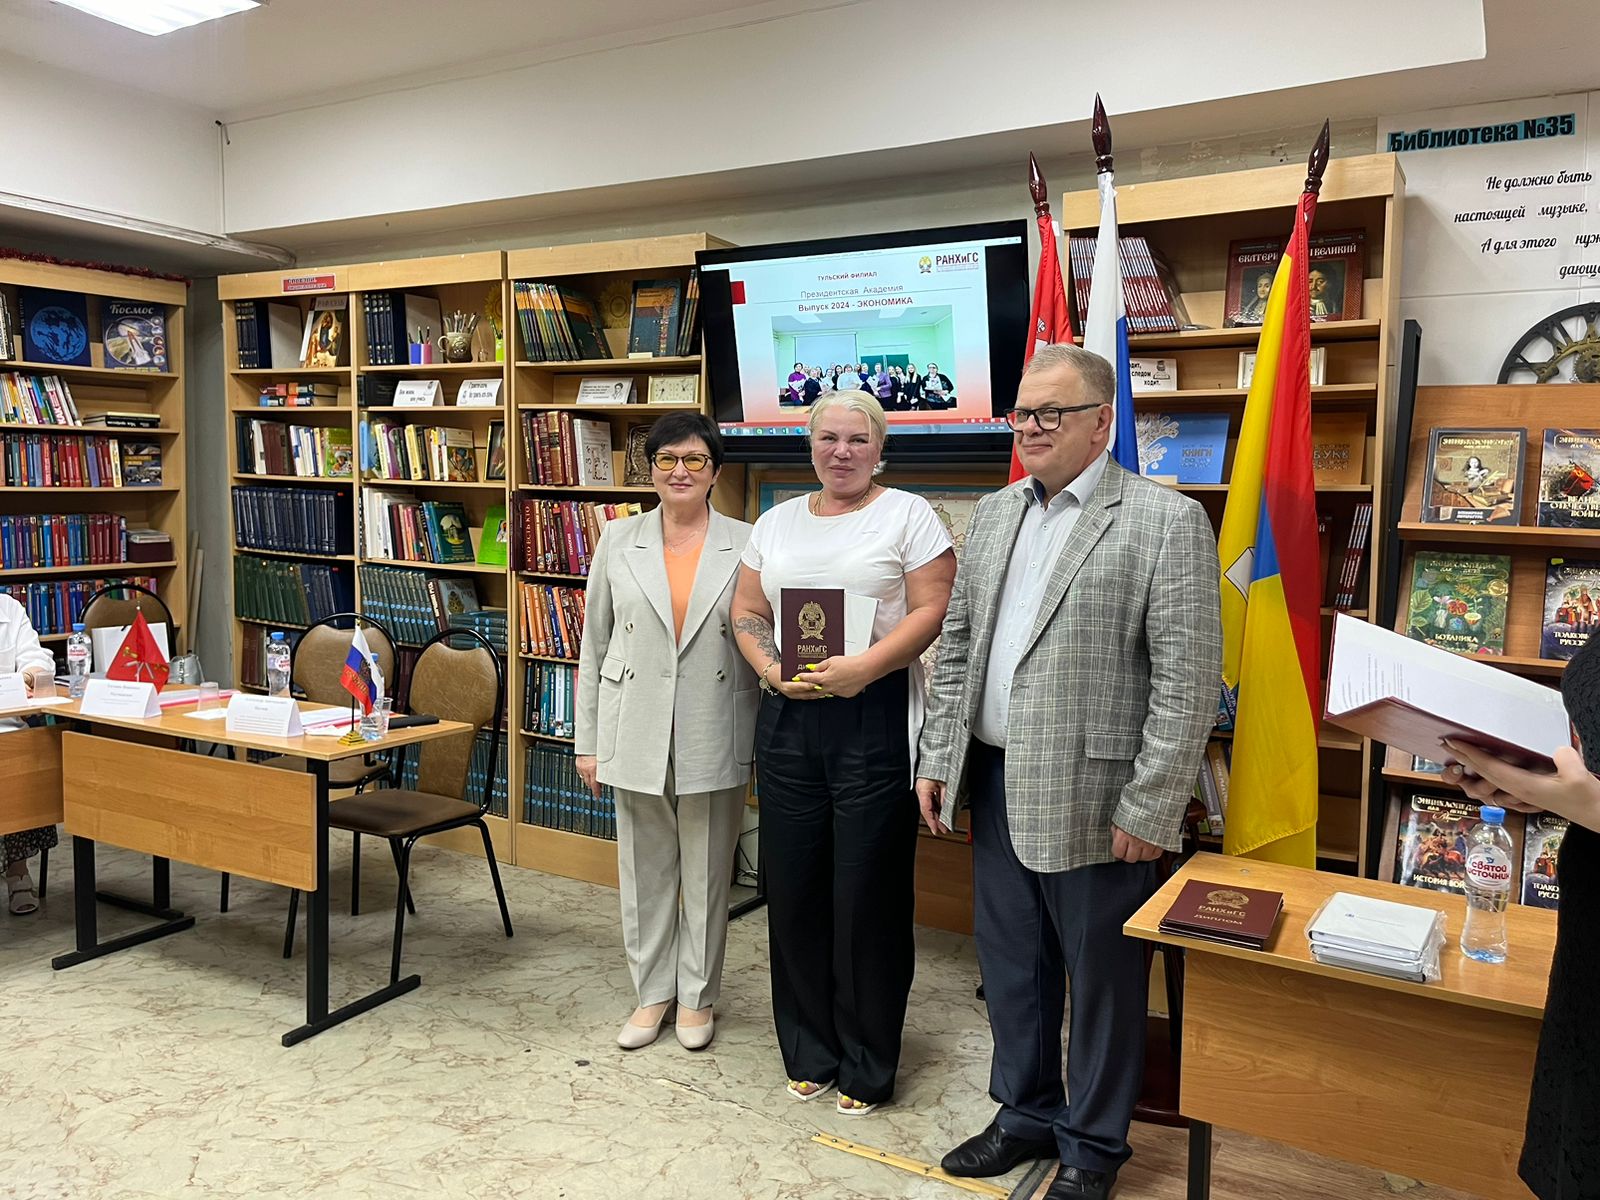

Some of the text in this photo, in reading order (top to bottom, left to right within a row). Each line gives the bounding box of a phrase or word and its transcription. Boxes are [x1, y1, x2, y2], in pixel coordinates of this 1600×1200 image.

[1390, 114, 1573, 152] Библиотека №35
[1486, 170, 1593, 192] Не должно быть
[1454, 202, 1588, 223] настоящей музыке,
[1481, 238, 1492, 253] А
[1493, 240, 1517, 255] для
[1519, 236, 1557, 250] этого
[936, 252, 979, 266] РАНХиГС
[817, 271, 877, 281] ТУЛЬСКИЙ ФИЛИАЛ
[800, 285, 903, 299] Президентская Академия
[110, 304, 154, 314] Космос
[798, 303, 829, 313] Выпуск
[831, 302, 850, 310] 2024
[857, 297, 913, 308] ЭКОНОМИКА
[1435, 633, 1478, 643] БОТАНИКА
[797, 644, 827, 653] РАНХиГС
[1471, 860, 1507, 873] СВЯТОЙ
[1413, 874, 1447, 886] ИСТОРИЯ
